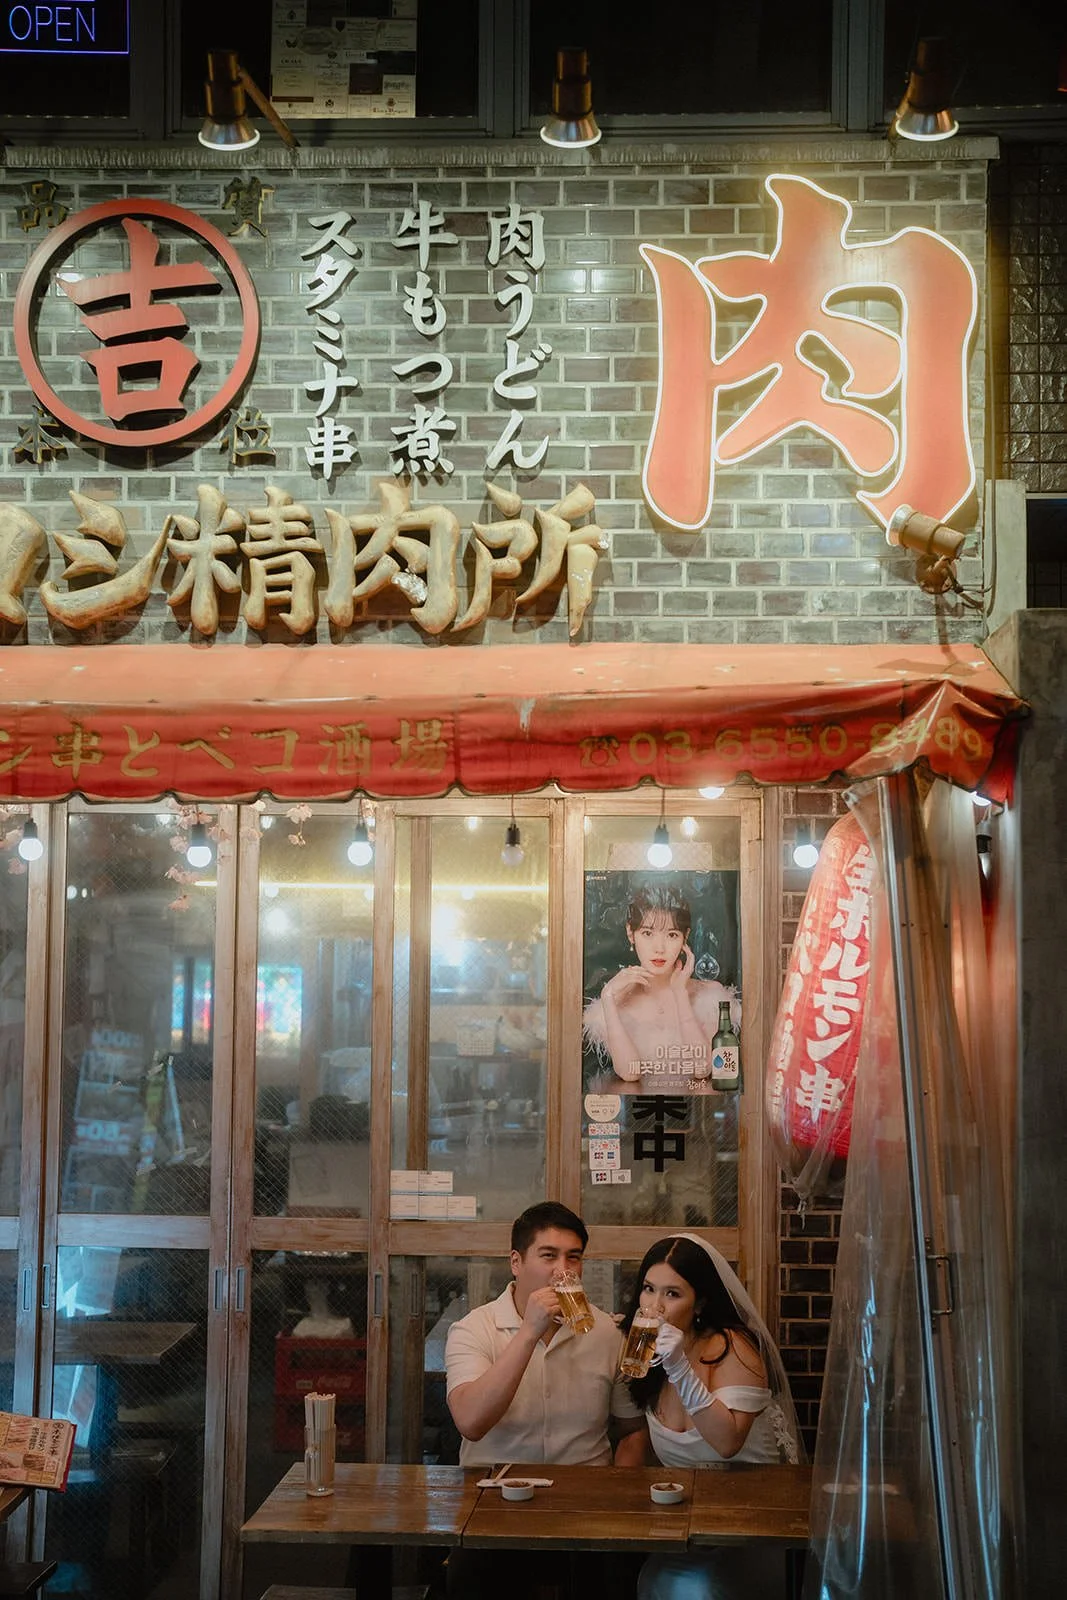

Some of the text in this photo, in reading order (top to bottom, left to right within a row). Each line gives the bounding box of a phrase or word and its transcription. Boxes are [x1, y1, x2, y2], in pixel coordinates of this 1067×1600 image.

[9, 5, 95, 41] OPEN
[55, 216, 222, 424] 吉
[300, 211, 358, 480] スタミナ串
[390, 200, 459, 474] 牛もつ煮
[487, 203, 552, 469] 肉うどん
[638, 174, 977, 532] 肉
[628, 1060, 665, 1075] 깨끗한
[656, 1045, 706, 1059] 이슬같이
